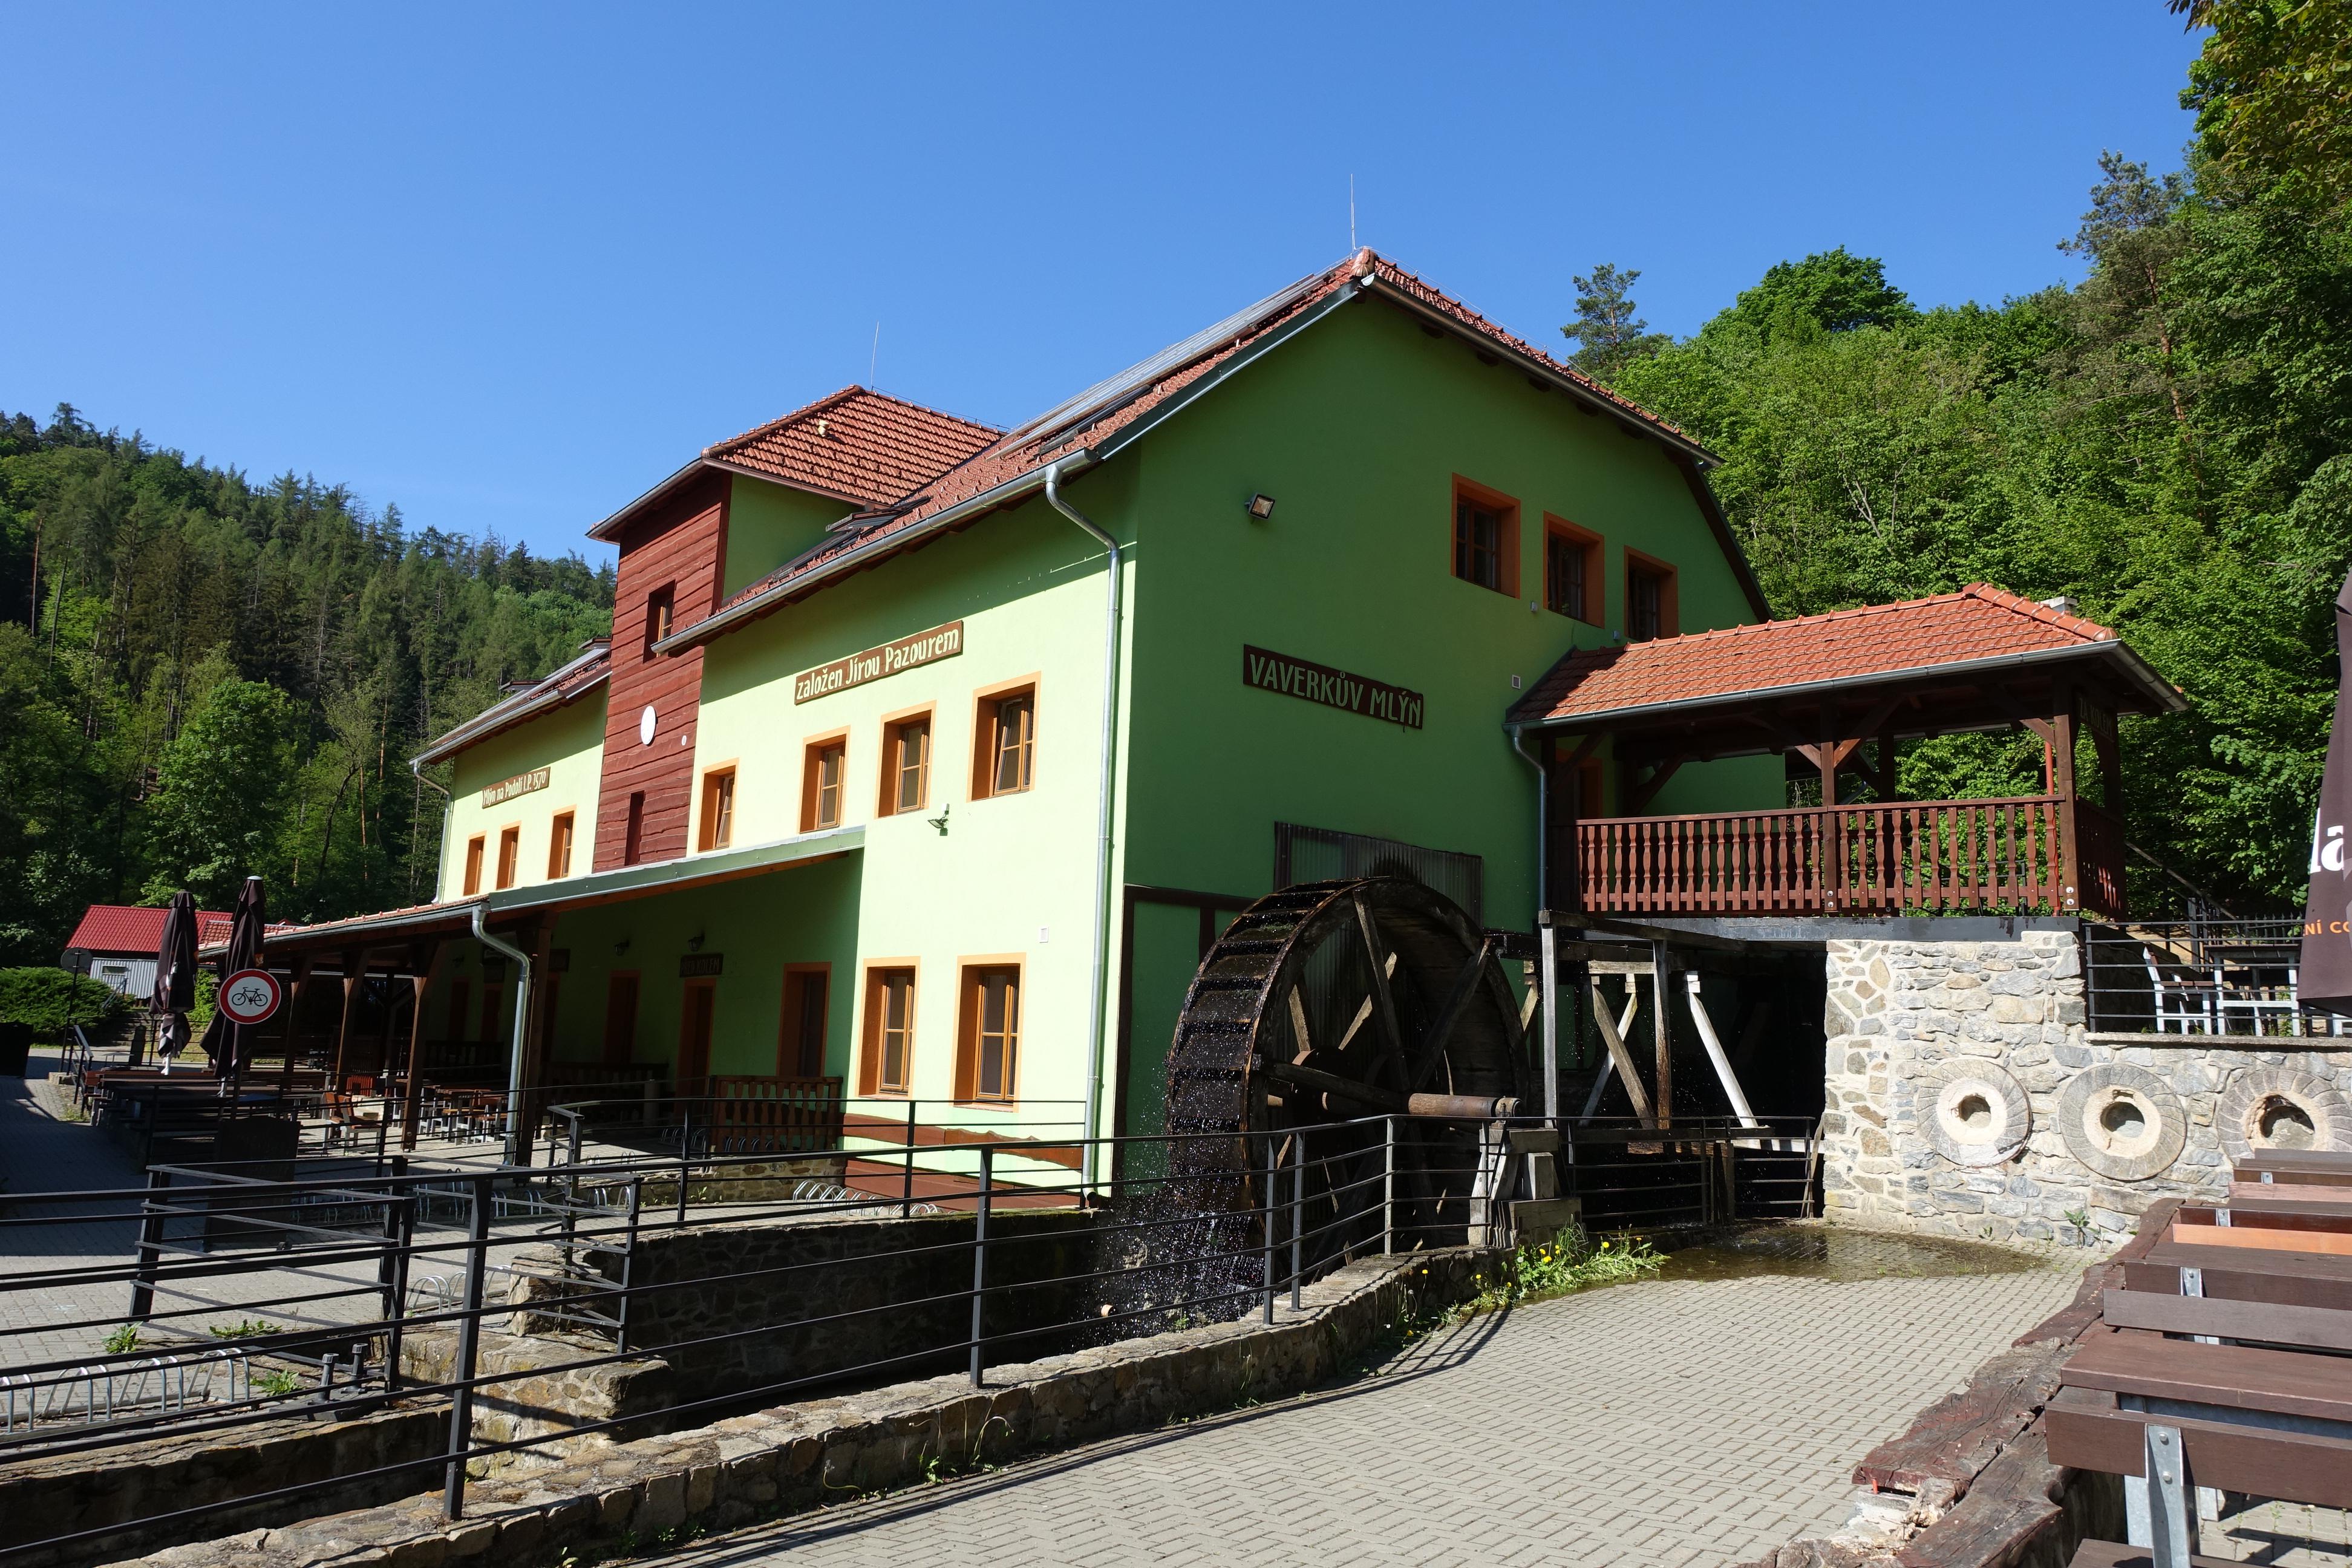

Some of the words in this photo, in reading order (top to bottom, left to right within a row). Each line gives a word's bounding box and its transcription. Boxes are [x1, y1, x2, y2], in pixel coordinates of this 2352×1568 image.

[797, 668, 842, 700] založen
[845, 656, 880, 685] Jírou
[884, 629, 959, 672] Pazourem
[1250, 654, 1364, 710] VAVERKŮV
[1370, 688, 1421, 726] MLÝN
[483, 788, 495, 806] Mlýn
[497, 788, 503, 800] na
[505, 777, 523, 798] Podolí
[534, 771, 546, 789] 1570
[2303, 920, 2322, 935] NÍ
